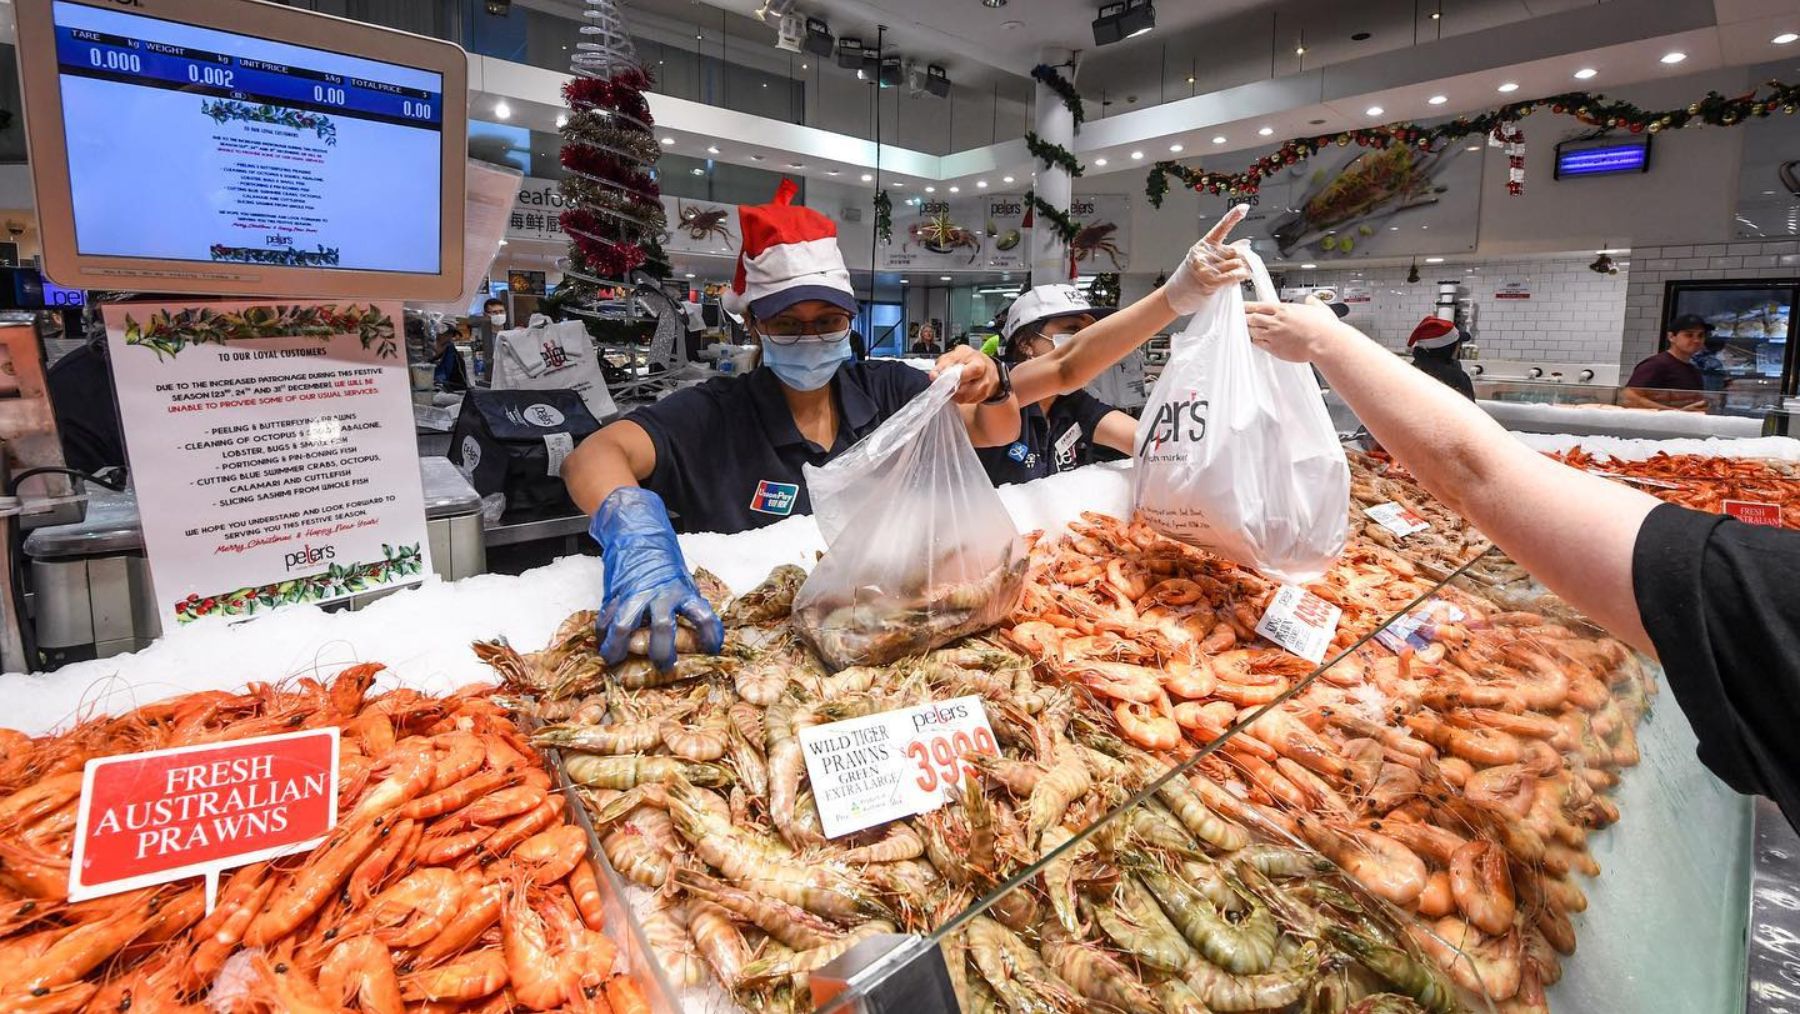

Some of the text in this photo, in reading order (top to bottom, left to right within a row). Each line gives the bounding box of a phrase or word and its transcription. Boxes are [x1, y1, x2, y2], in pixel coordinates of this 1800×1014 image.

[72, 30, 140, 48] TARE kg
[90, 48, 140, 72] 0.000
[146, 42, 228, 63] WEIGHT kg
[188, 63, 234, 88] 0.002
[240, 59, 259, 68] UNIT
[261, 61, 289, 73] PRICE
[314, 85, 345, 105] 0.00
[403, 101, 431, 119] 0.00
[219, 348, 327, 362] TO OUR LOYAL CUSTOMERS
[210, 378, 256, 387] INCREASED
[258, 374, 306, 383] PATRONAGE
[354, 368, 383, 376] FESTIVE
[168, 404, 202, 413] UNABLE
[220, 399, 257, 407] PROVIDE
[259, 396, 282, 404] SOME
[318, 391, 340, 399] USUAL
[172, 393, 210, 401] SEASON
[212, 425, 249, 434] PEELING
[185, 438, 234, 450] CLEANING
[236, 436, 250, 444] OF
[253, 431, 297, 442] OCTOPUS
[222, 447, 265, 458] LOBSTER,
[267, 444, 290, 452] BUGS
[222, 457, 279, 470] PORTIONING
[289, 449, 338, 460] PIN-BONING
[196, 475, 237, 486] CUTTING
[240, 471, 260, 480] BLUE
[263, 466, 304, 477] SWIMMER
[230, 469, 351, 493] CALAMARI AND CUTTLEFISH
[220, 495, 254, 507] SLICING
[257, 490, 292, 501] SASHIMI
[294, 485, 320, 494] FROM
[321, 479, 350, 490] WHOLE
[352, 477, 369, 485] FISH
[201, 524, 226, 534] HOPE
[228, 521, 246, 530] YOU
[248, 510, 300, 527] UNDERSTAND
[303, 507, 320, 516] AND
[321, 504, 344, 513] LOOK
[346, 498, 384, 510] FORWARD
[1736, 515, 1778, 526] TRALIAN
[1740, 507, 1765, 516] FRESH
[214, 542, 245, 554] Merry
[247, 534, 291, 549] Christmas
[304, 526, 333, 537] Happy
[335, 522, 354, 533] New
[224, 529, 261, 540] SERVING
[263, 525, 280, 534] YOU
[283, 521, 299, 530] THIS
[301, 516, 332, 527] FESTIVE
[810, 725, 890, 756] WILD TIGER
[822, 745, 889, 774] PRAWNS
[165, 755, 274, 794] FRESH
[838, 766, 879, 784] GREEN
[825, 772, 898, 801] EXTRA LARGE
[93, 773, 326, 837] AUSTRALIAN
[135, 806, 288, 859] PRAWNS
